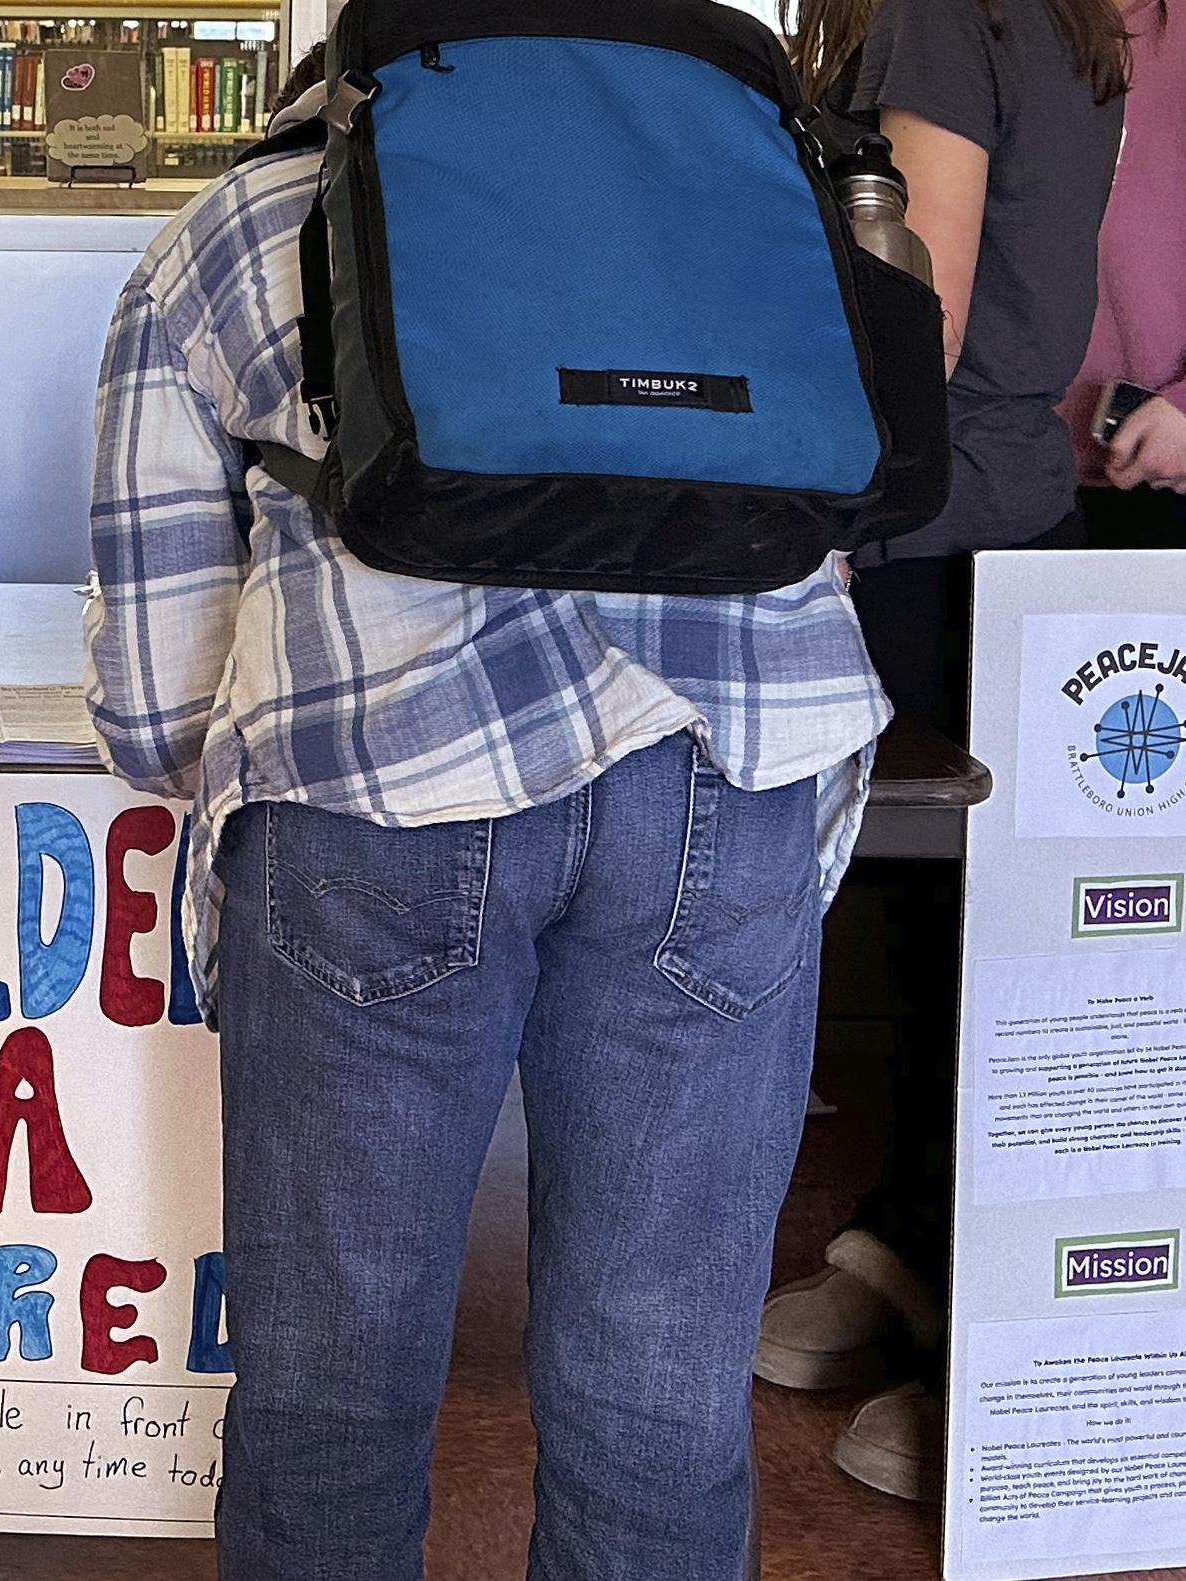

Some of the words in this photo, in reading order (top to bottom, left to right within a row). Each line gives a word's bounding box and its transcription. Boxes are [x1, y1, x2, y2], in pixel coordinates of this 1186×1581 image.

[85, 133, 100, 141] and
[619, 377, 698, 392] TIMBUK2
[1061, 642, 1186, 706] PEACEJA
[1067, 745, 1115, 814] BRATTLEBORO
[1116, 805, 1156, 818] UNION
[1157, 788, 1186, 812] HIGH
[1085, 892, 1169, 920] Vision
[1139, 1009, 1157, 1017] peace
[1093, 1122, 1114, 1130] person
[1068, 1252, 1168, 1281] Mission
[980, 1381, 993, 1389] Our
[994, 1379, 1021, 1387] mission
[1068, 1374, 1107, 1383] generation
[1108, 1372, 1115, 1380] of
[1116, 1372, 1137, 1380] young
[979, 1395, 1005, 1403] change
[1118, 1385, 1132, 1393] and
[989, 1407, 1010, 1415] Nobel
[1011, 1406, 1033, 1414] Peace
[1139, 1397, 1153, 1405] and
[67, 1404, 91, 1432] in
[120, 1395, 190, 1440] front
[212, 1418, 225, 1440] o
[981, 1443, 1003, 1451] Nobel
[1124, 1433, 1155, 1442] powerful
[1155, 1431, 1169, 1439] and
[18, 1456, 65, 1490] any
[82, 1441, 148, 1479] time
